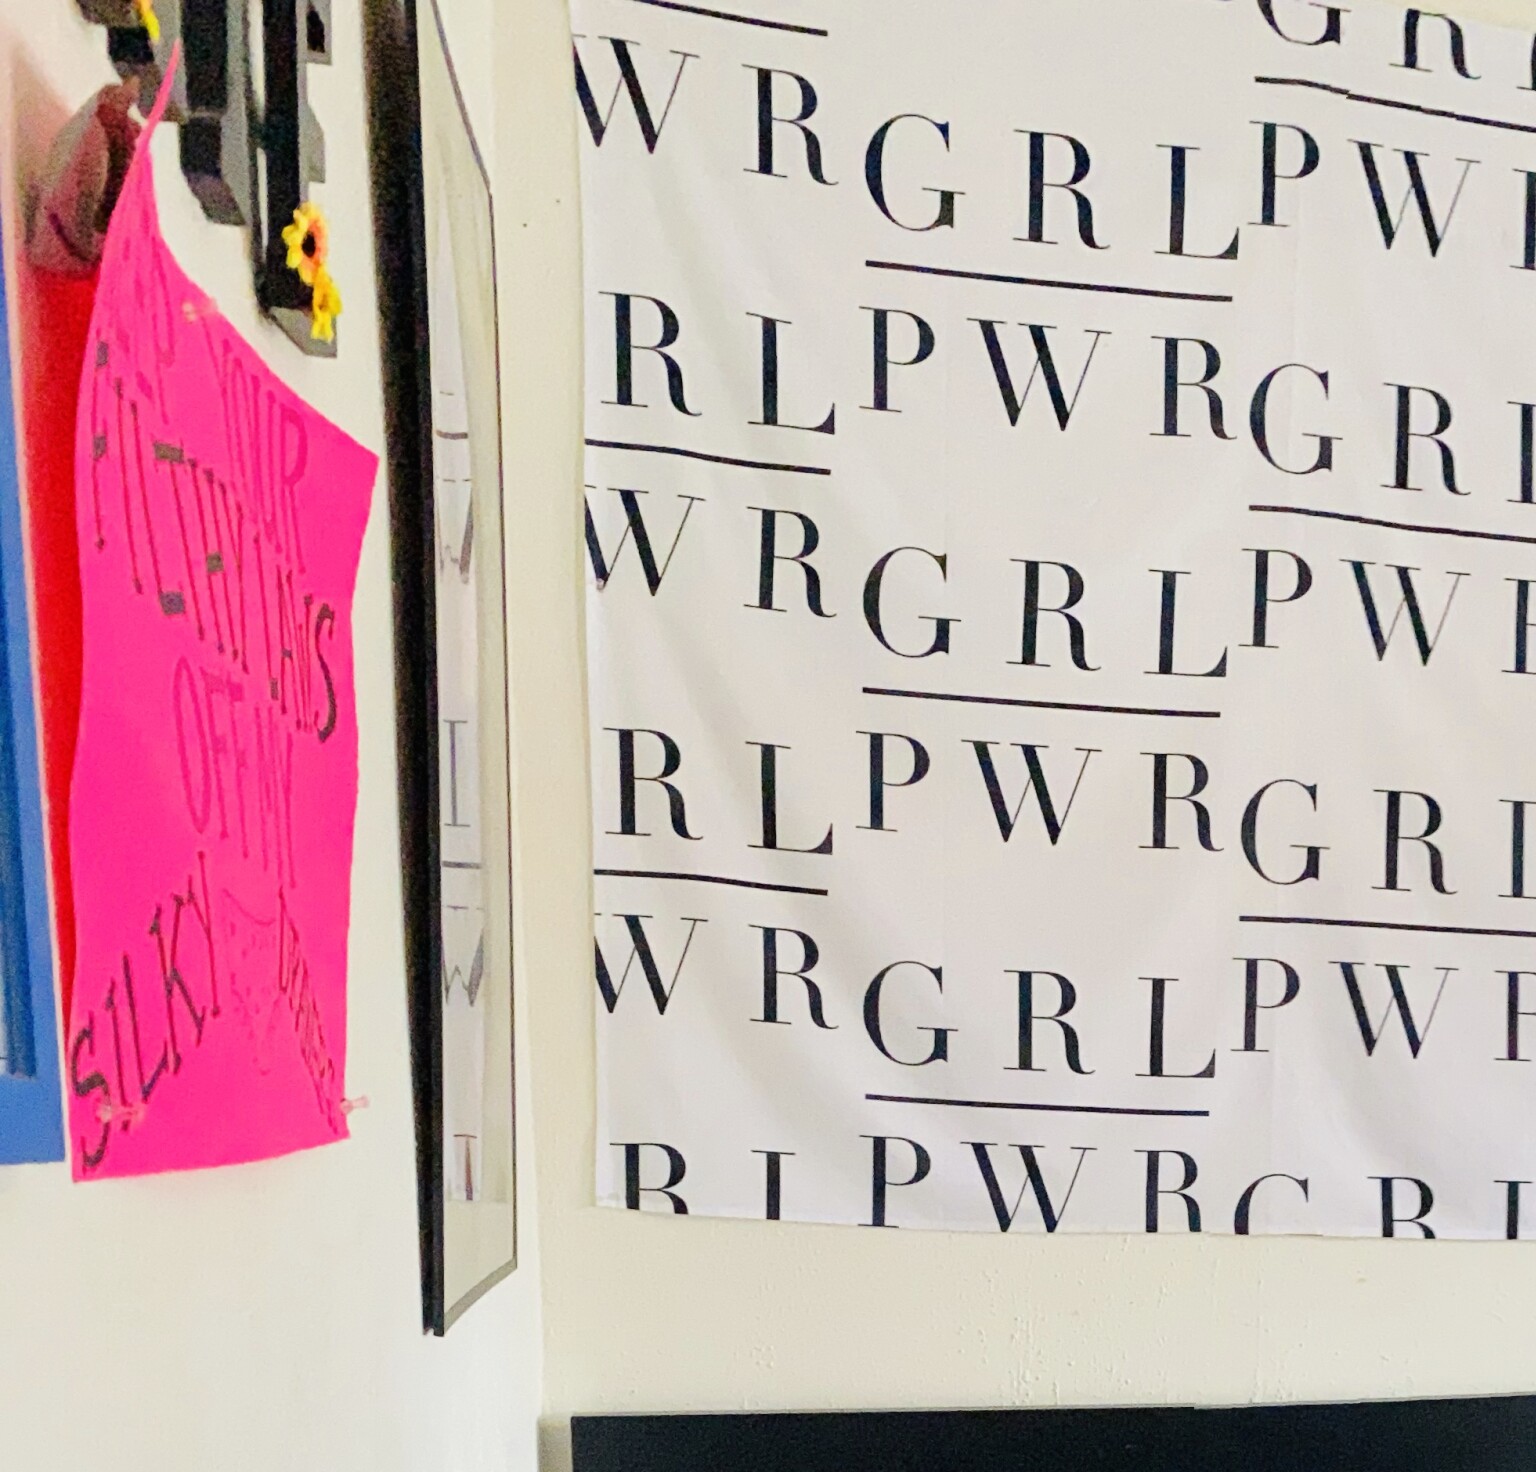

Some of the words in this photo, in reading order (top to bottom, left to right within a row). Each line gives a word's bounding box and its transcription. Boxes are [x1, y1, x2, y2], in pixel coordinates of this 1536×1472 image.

[864, 113, 1240, 260] GRL
[859, 306, 1236, 442] PWR
[92, 333, 250, 675] FILTHY
[253, 531, 338, 742] LAWS
[862, 546, 1229, 679] GRL
[173, 653, 249, 860] OFF
[254, 703, 297, 888] MY
[855, 730, 1225, 853] PWR
[69, 849, 220, 1169] SILKY
[862, 960, 1217, 1080] GRL
